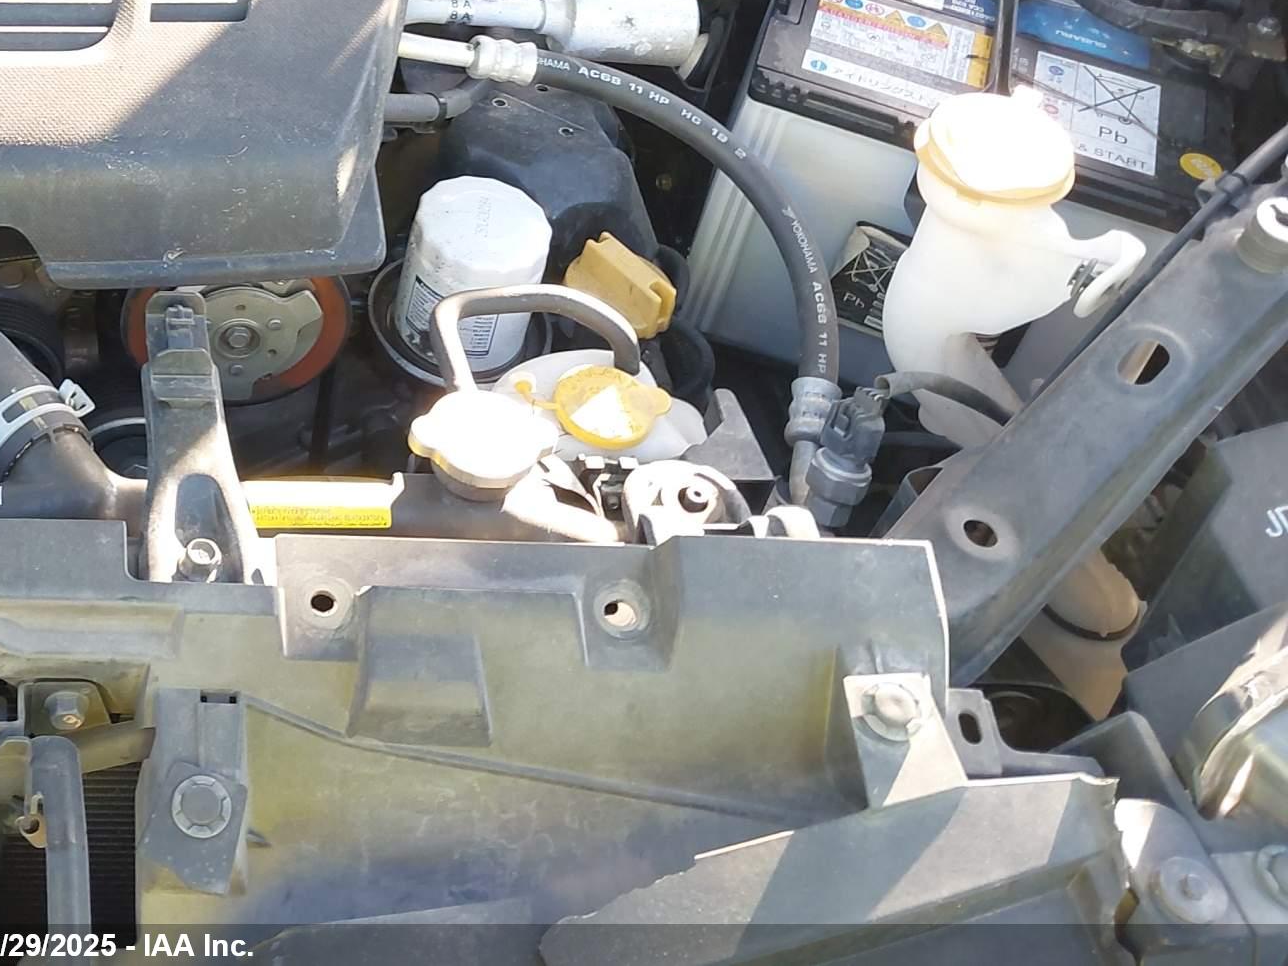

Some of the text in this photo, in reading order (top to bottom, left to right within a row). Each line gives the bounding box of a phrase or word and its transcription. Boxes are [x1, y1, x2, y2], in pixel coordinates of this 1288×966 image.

[628, 82, 643, 94] 11
[648, 90, 670, 105] HP
[1098, 125, 1128, 144] Pb
[1094, 146, 1148, 171] START
[791, 221, 819, 274] YOKOHAMA
[818, 332, 828, 347] 11
[816, 354, 827, 373] HP
